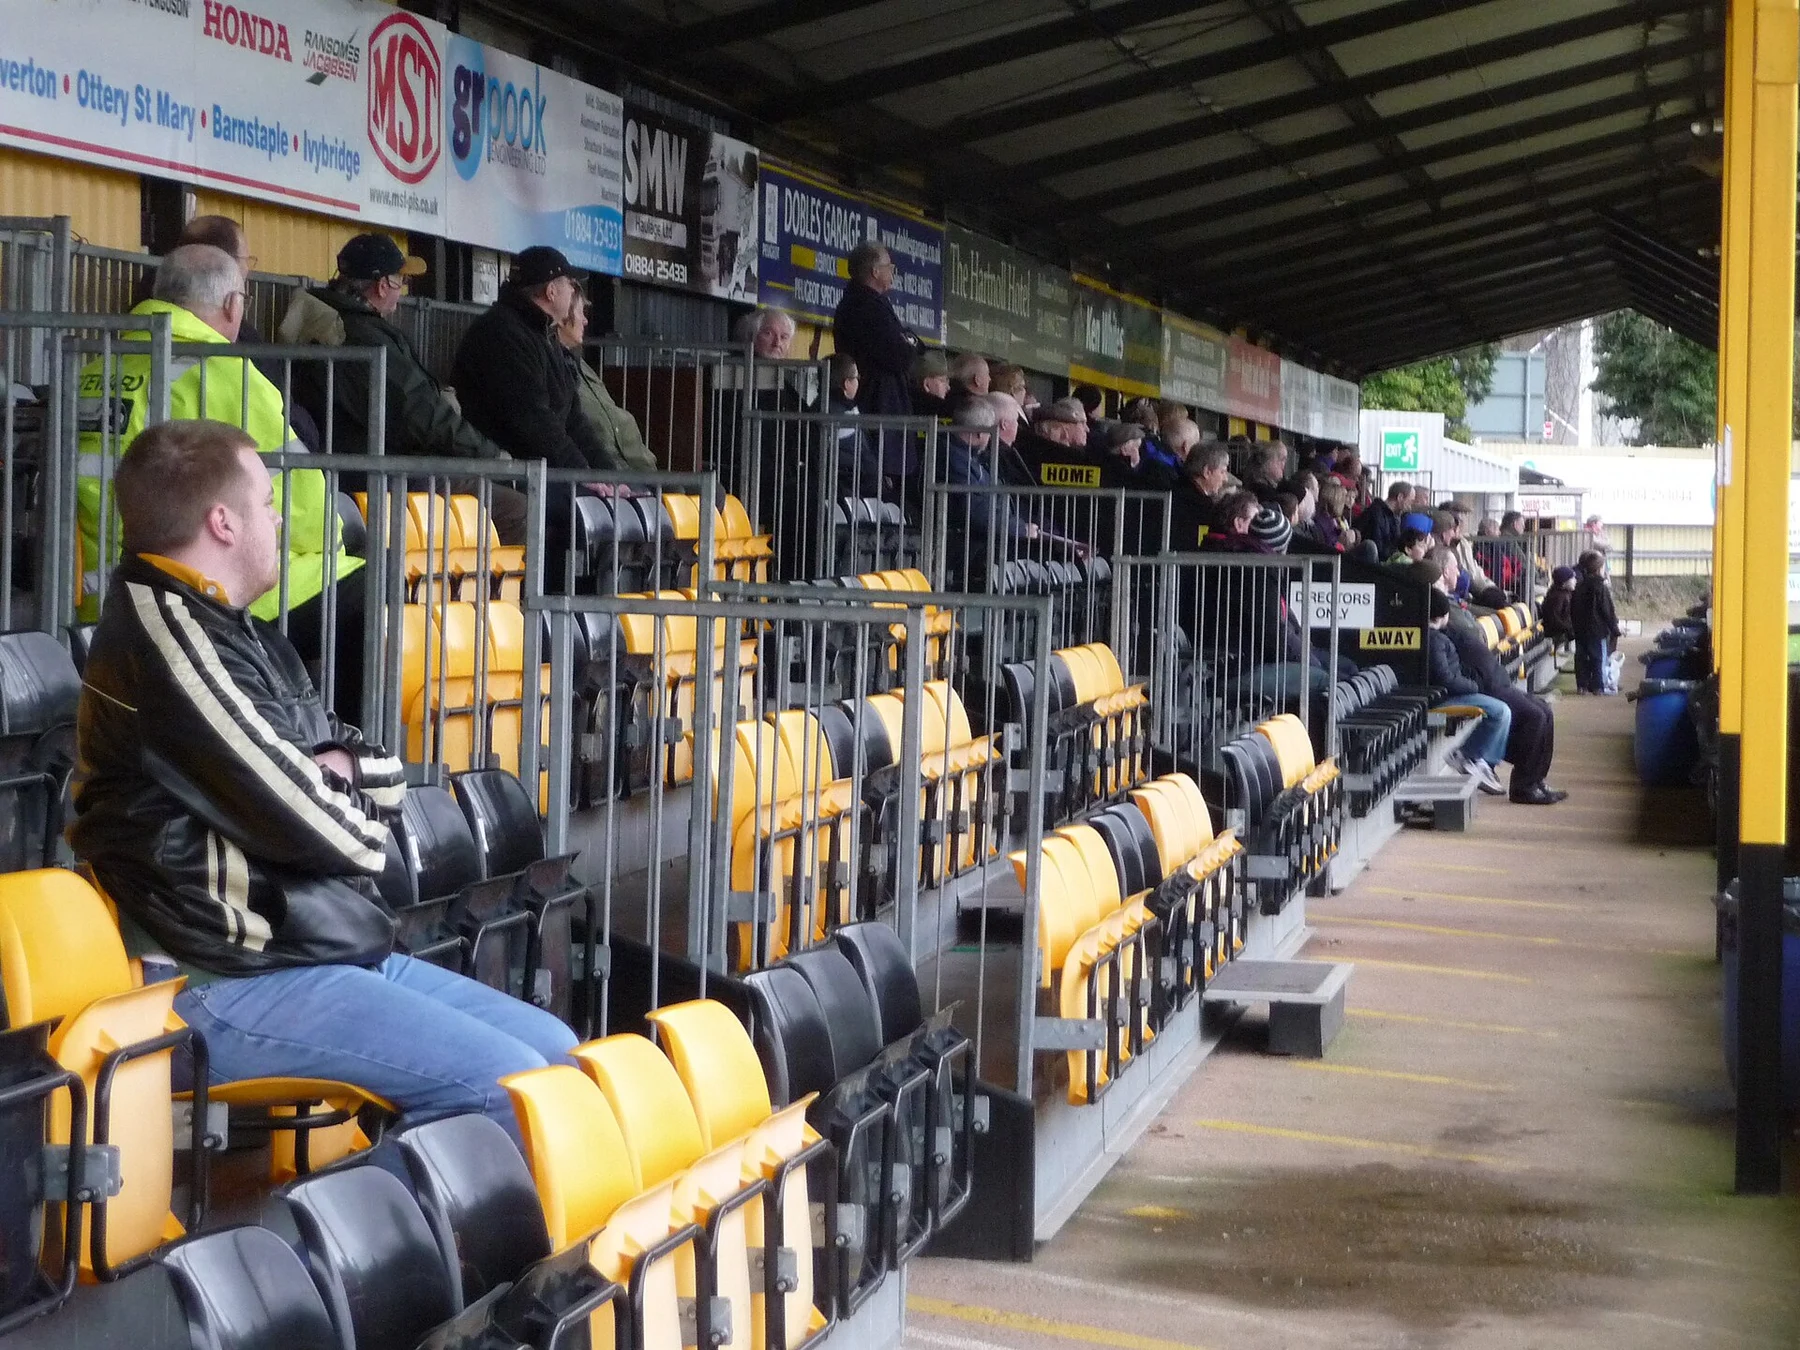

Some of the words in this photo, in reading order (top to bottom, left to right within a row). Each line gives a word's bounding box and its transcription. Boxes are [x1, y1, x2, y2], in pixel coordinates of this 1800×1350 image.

[204, 0, 292, 62] HONDA
[304, 30, 360, 64] RANSOMES
[303, 50, 358, 83] JACOBSEN
[372, 33, 437, 165] MST
[77, 69, 130, 127] Ottery
[135, 84, 152, 123] St
[157, 89, 196, 142] Mary
[212, 103, 289, 161] Barnstaple
[303, 129, 361, 182] Ivybridge
[625, 118, 688, 216] SMW
[564, 209, 592, 243] 01884
[784, 187, 821, 243] DOBLES
[823, 202, 861, 252] GARAGE
[625, 253, 655, 278] 01884
[656, 259, 688, 284] 254331
[950, 242, 968, 299] The
[1008, 263, 1031, 318] Hotel
[1385, 443, 1402, 457] EXIT
[1046, 465, 1095, 484] HOME
[1366, 630, 1415, 645] AWAY
